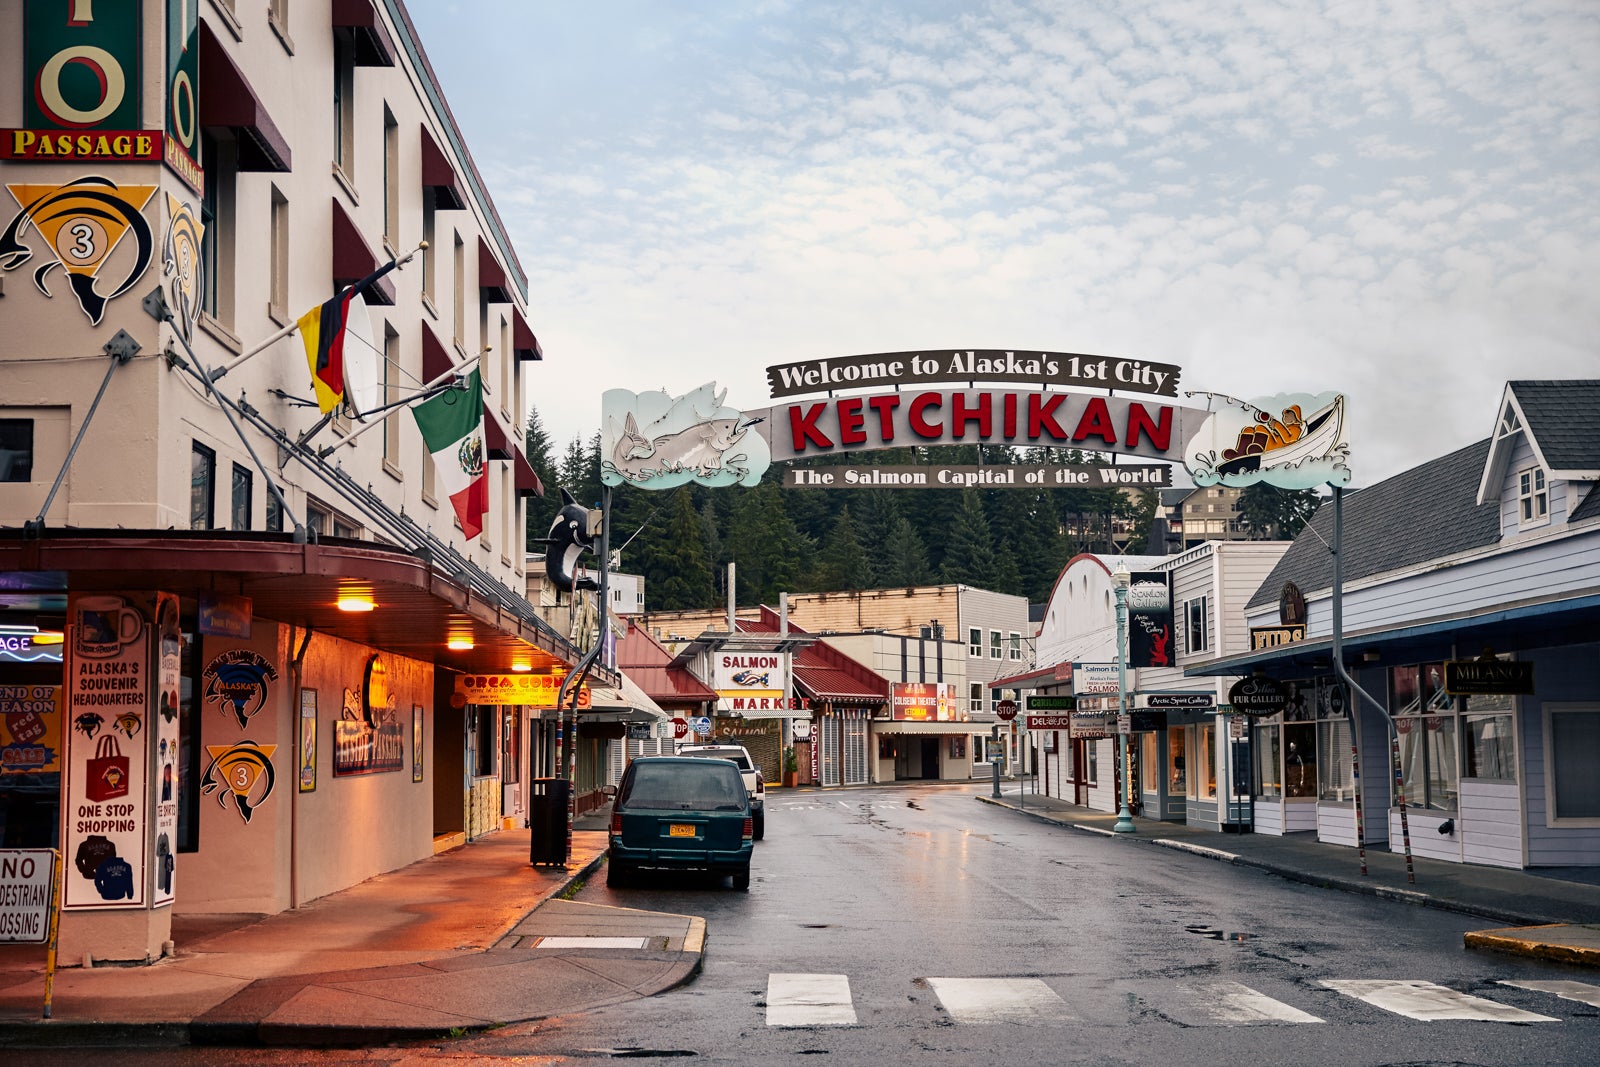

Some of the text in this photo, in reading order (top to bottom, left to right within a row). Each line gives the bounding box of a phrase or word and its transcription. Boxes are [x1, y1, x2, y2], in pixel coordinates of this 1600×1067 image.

[13, 130, 153, 156] PASSAGE
[168, 137, 202, 191] PASSAGE
[69, 223, 94, 259] 3
[778, 351, 1170, 393] Welcome to Alaska's 1st City
[788, 391, 1174, 452] KETCHIKAN
[792, 468, 1163, 488] The Salmon Capital of the World
[80, 662, 139, 675] ALASKA'S
[722, 656, 778, 669] SALMON
[1456, 664, 1524, 681] MILANO
[80, 678, 138, 690] SOUVENIR
[219, 682, 258, 691] ALASKA'S
[464, 676, 514, 688] ORCA
[1088, 685, 1120, 693] SALMON
[32, 687, 54, 699] OF
[73, 692, 144, 706] HEADQUARTERS
[1233, 695, 1285, 704] FUR GALLERY
[733, 697, 811, 710] MARKET
[894, 696, 916, 705] COLISEUM
[917, 697, 937, 706] THEATRE
[1170, 696, 1187, 705] Spirit
[1187, 696, 1209, 705] Gallery
[997, 706, 1016, 715] STOP
[12, 712, 35, 731] red
[18, 723, 42, 741] tag
[339, 727, 401, 763] INSIDE PASSAGE
[810, 725, 818, 777] COFFEE
[3, 748, 45, 764] SALE
[236, 767, 248, 786] 3
[78, 804, 135, 818] ONE STOP
[77, 819, 135, 833] SHOPPING
[2, 858, 37, 881] NO
